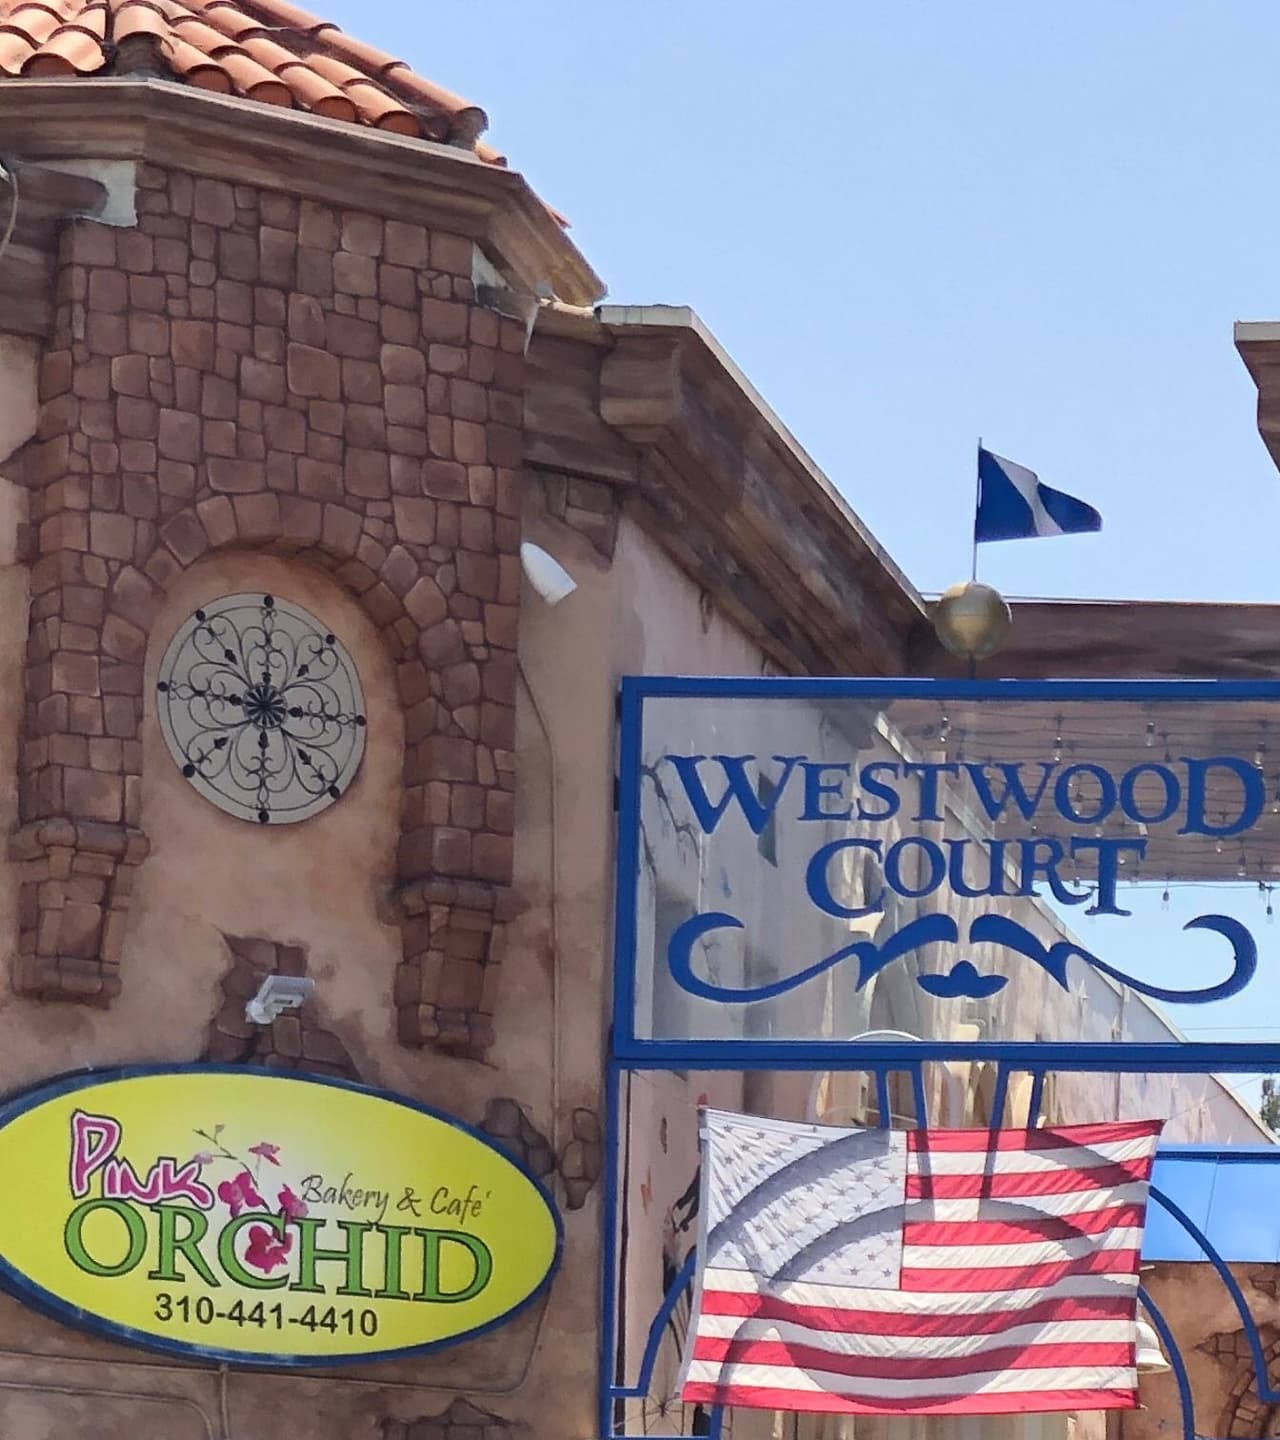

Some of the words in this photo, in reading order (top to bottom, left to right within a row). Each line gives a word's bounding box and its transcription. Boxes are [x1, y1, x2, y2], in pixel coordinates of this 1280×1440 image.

[665, 754, 1266, 836] WESTWOOD
[806, 836, 1148, 919] COURT
[300, 1172, 389, 1225] Bakery
[396, 1187, 422, 1218] &
[64, 1198, 493, 1304] ORCHID
[154, 1293, 378, 1337] 310-441-4410
